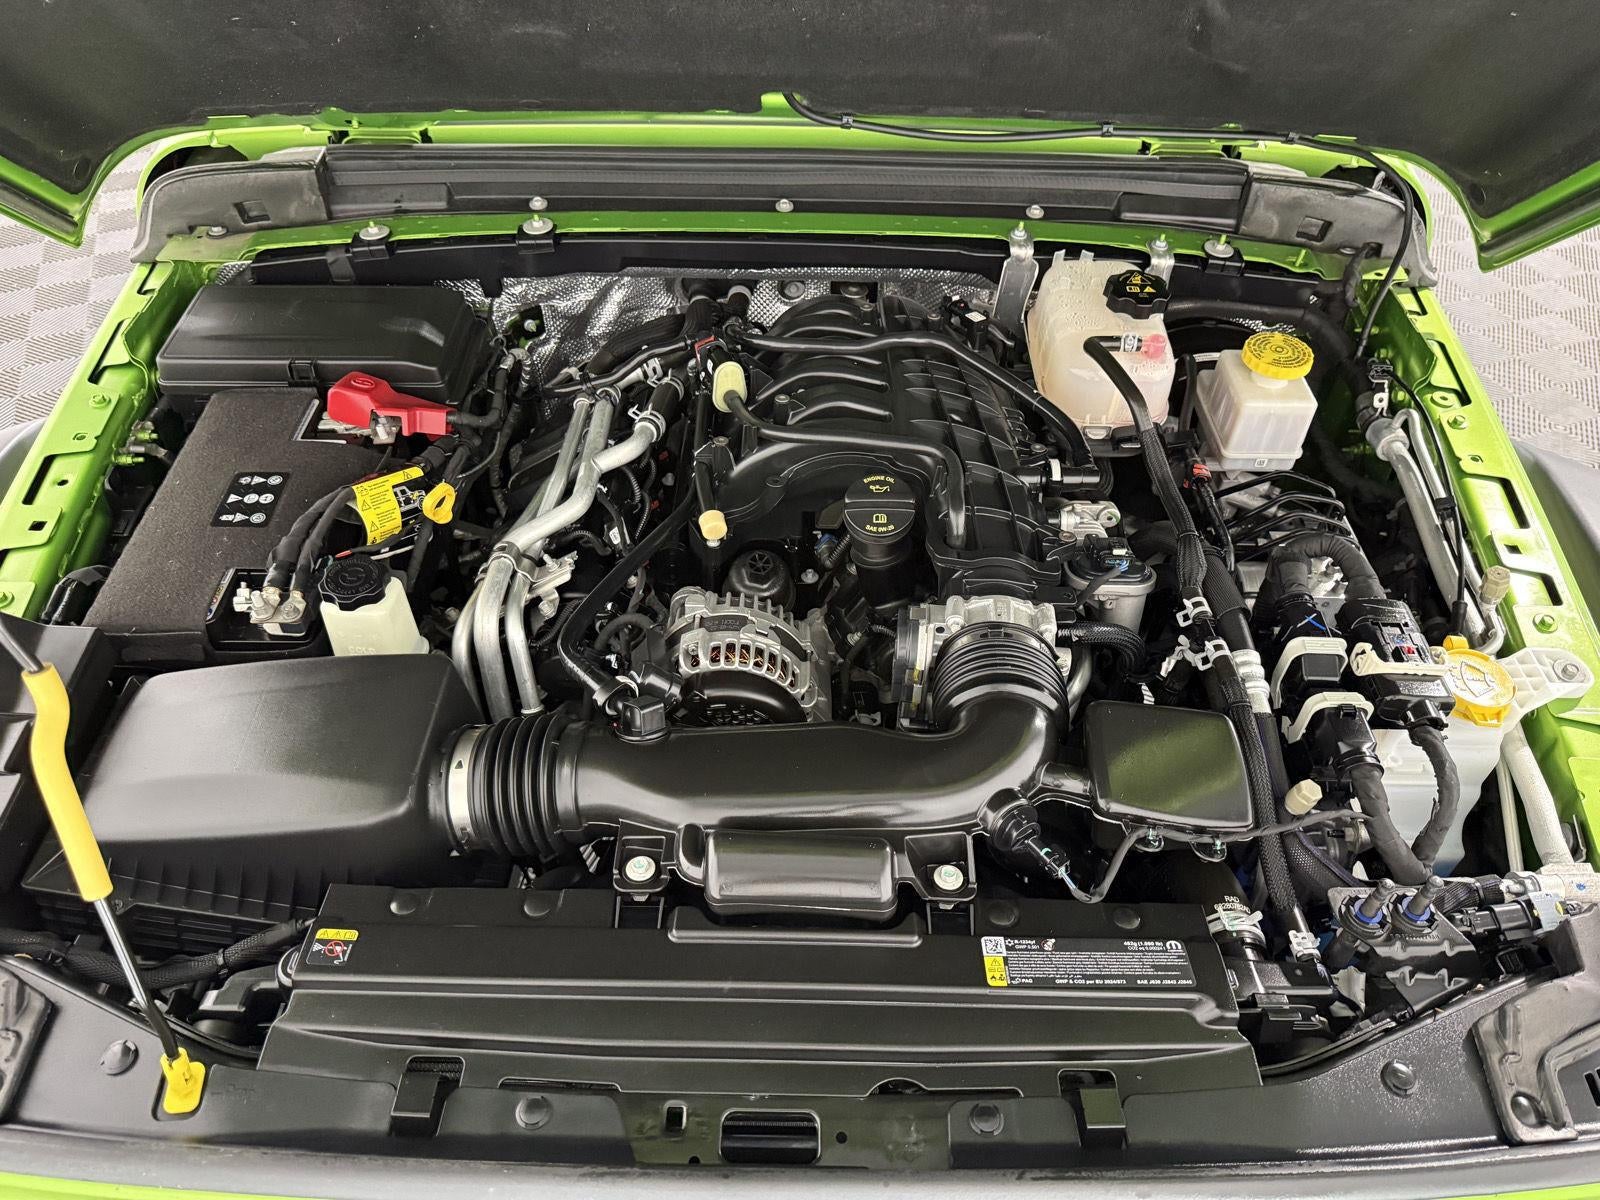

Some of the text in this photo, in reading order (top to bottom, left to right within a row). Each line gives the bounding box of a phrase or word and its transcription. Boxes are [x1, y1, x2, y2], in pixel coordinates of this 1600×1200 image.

[863, 475, 895, 484] ENGINE OIL
[865, 524, 895, 532] SAE 0W-20
